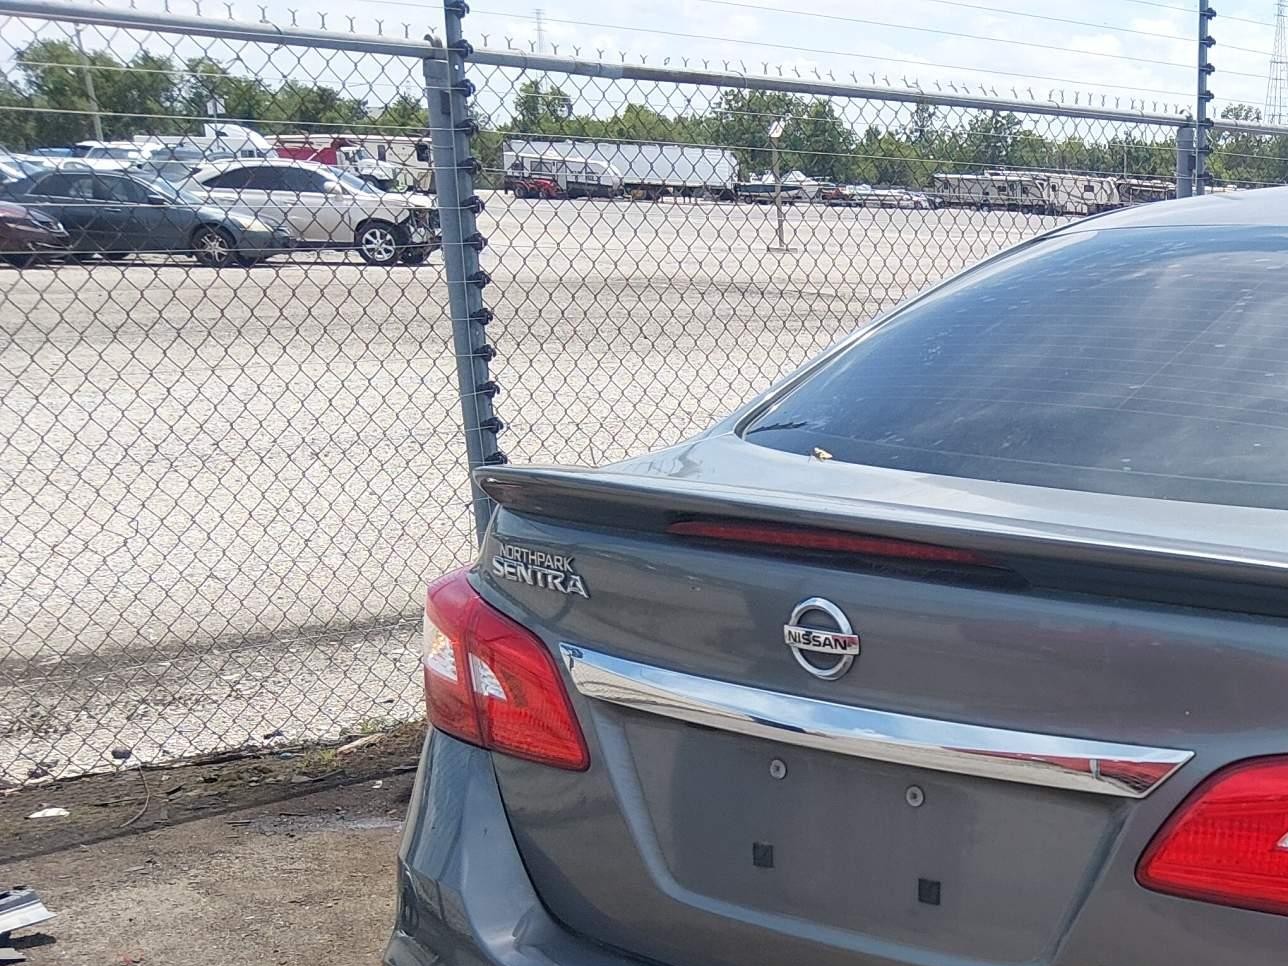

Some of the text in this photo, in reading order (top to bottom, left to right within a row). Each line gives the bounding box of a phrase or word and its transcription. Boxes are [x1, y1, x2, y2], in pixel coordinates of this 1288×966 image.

[500, 542, 575, 573] NORTHPARK
[492, 556, 590, 599] SENTRA
[787, 630, 848, 651] NISSAN
